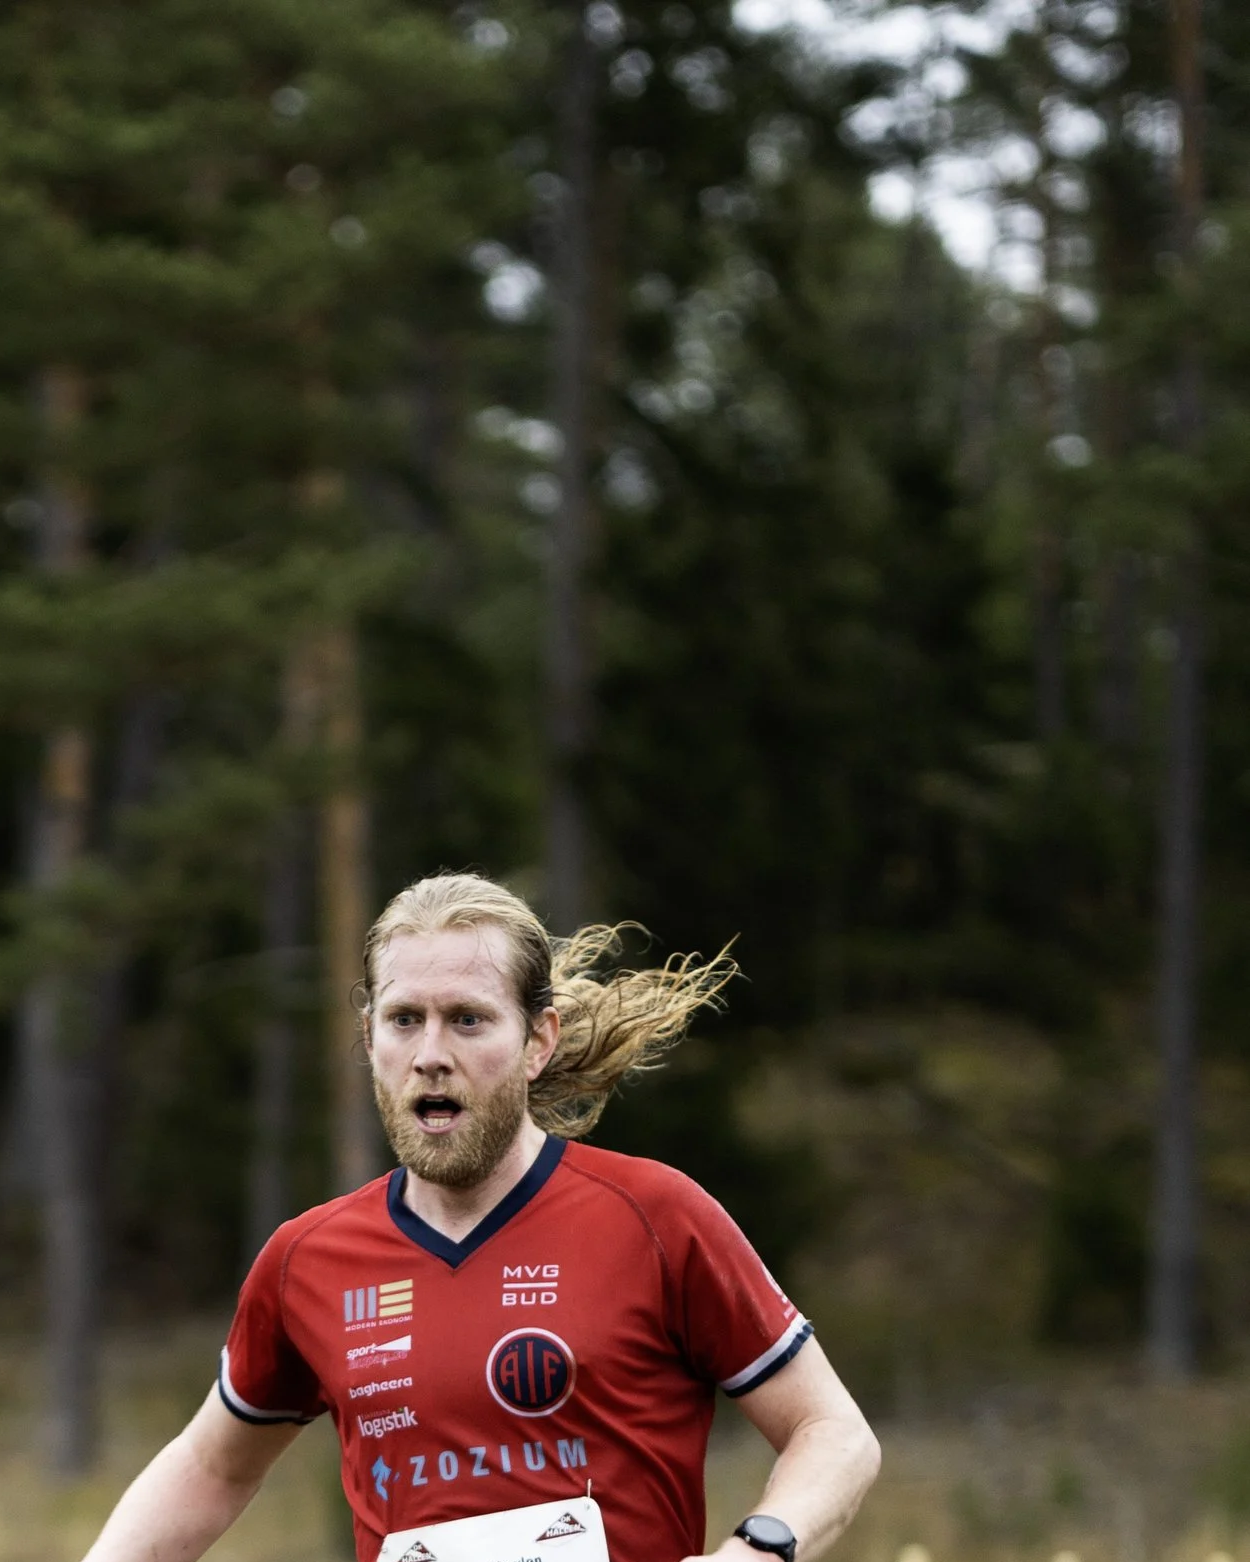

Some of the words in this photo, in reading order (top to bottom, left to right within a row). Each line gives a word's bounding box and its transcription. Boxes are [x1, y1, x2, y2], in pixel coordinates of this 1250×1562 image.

[502, 1264, 560, 1279] MVG
[501, 1291, 558, 1307] BUD
[345, 1321, 377, 1332] MODERN
[378, 1314, 413, 1326] EKONOMI
[346, 1342, 377, 1361] sport
[348, 1377, 414, 1399] bagheera
[357, 1405, 419, 1439] logistik
[410, 1438, 588, 1487] ZOZIUM
